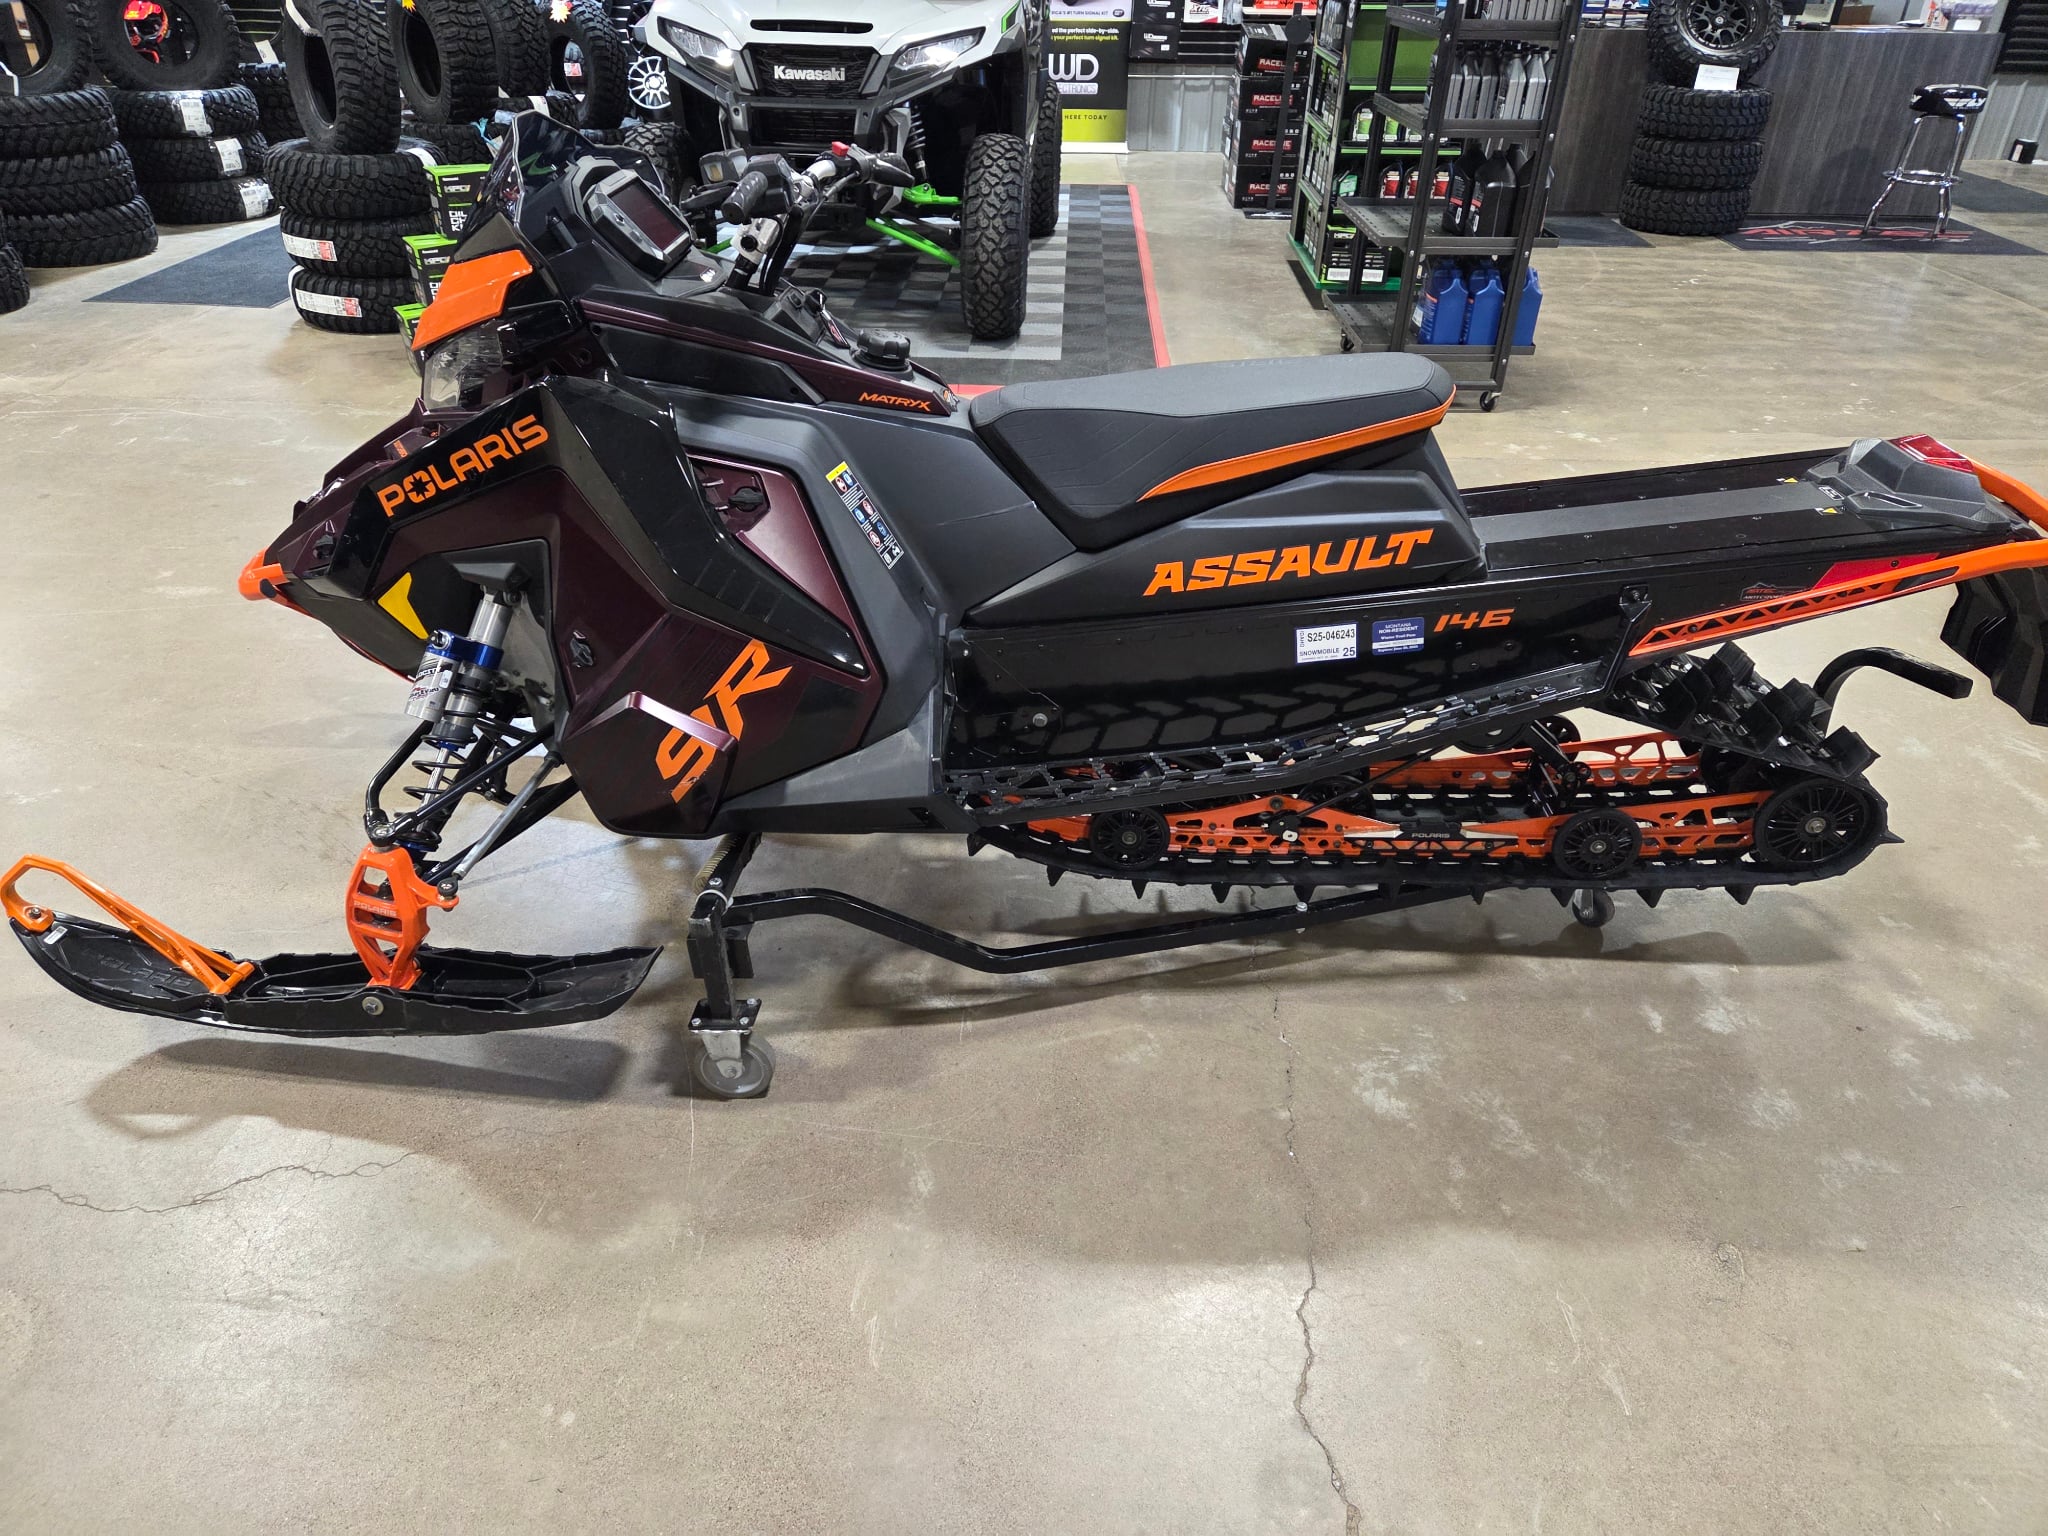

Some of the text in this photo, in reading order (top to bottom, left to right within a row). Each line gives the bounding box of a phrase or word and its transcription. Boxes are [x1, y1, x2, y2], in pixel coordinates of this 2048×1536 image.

[774, 65, 846, 81] Kawasaki
[1048, 53, 1099, 80] WD
[1059, 83, 1097, 93] ECTRONICS
[1252, 140, 1292, 148] RACENE
[1249, 183, 1288, 191] RACENE
[859, 392, 931, 411] MATRYX
[377, 414, 549, 517] POLARIS
[1143, 528, 1434, 596] ASSAULT
[1434, 608, 1515, 632] 146
[1307, 629, 1355, 642] S25-046243
[1379, 626, 1418, 634] NON-RESIDENT
[1300, 647, 1355, 656] SNOWMOBILE 25
[656, 638, 793, 803] SR
[353, 900, 397, 917] POLARIS
